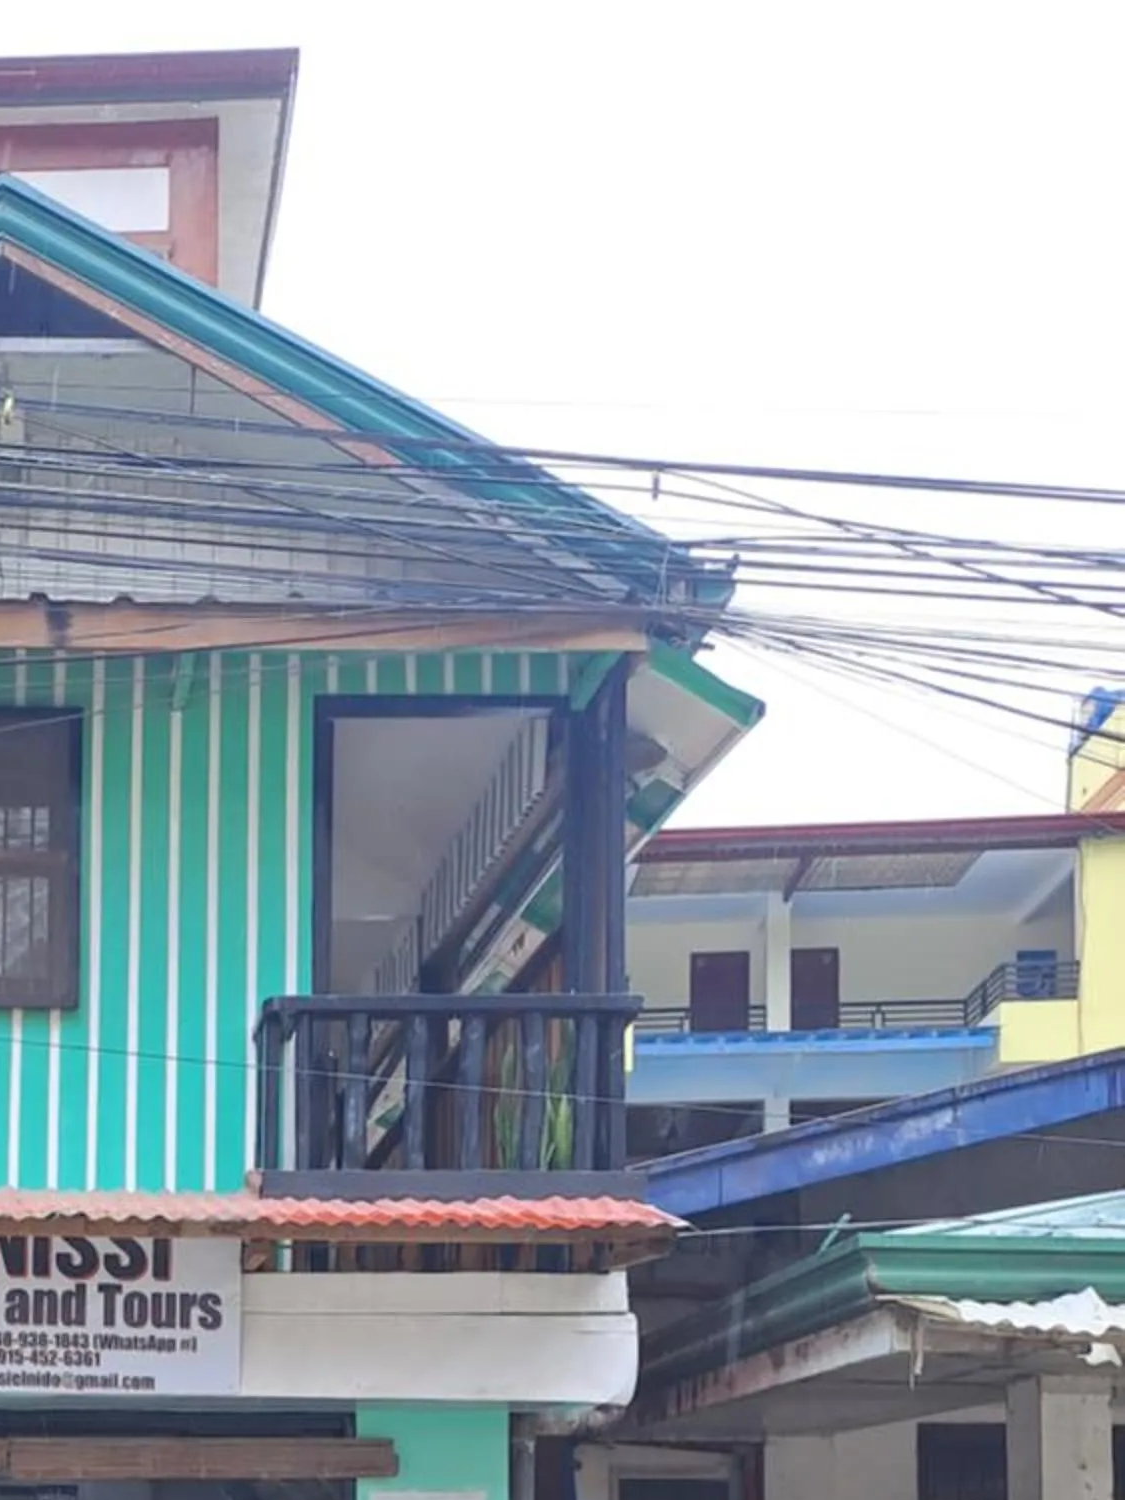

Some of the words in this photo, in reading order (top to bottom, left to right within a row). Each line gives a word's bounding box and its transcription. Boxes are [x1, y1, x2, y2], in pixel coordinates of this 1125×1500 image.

[5, 1282, 86, 1326] and
[97, 1282, 222, 1330] Tours
[93, 1333, 177, 1352] (WhatsApp
